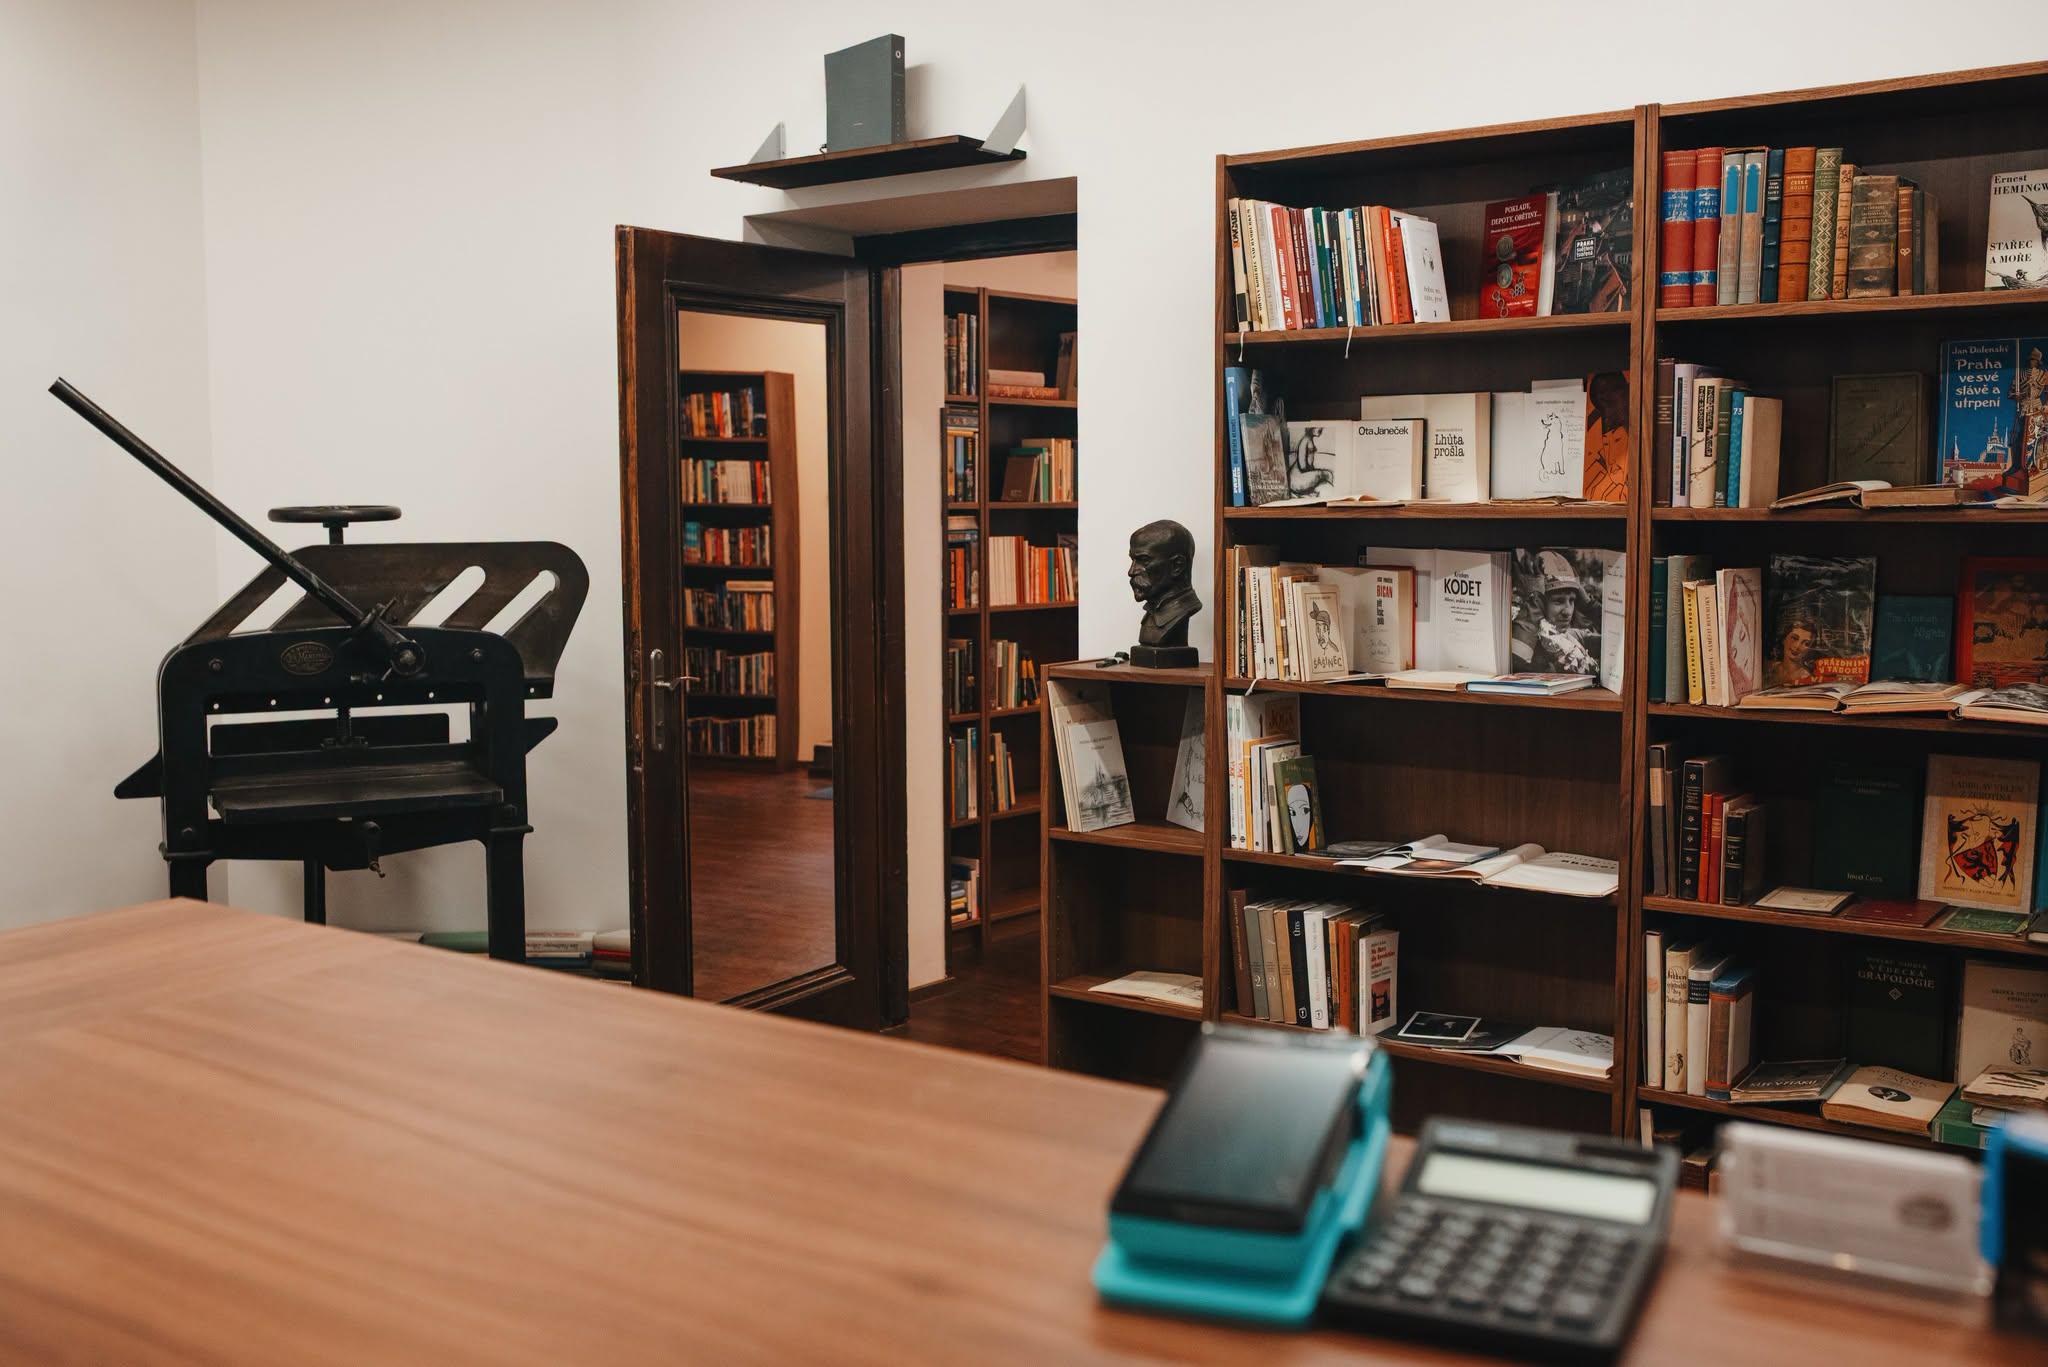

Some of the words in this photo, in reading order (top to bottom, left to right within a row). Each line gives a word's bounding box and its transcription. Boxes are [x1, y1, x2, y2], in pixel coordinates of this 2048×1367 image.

[1994, 174, 2027, 184] Ernest
[1504, 202, 1531, 214] POKLADY,
[1576, 239, 1594, 248] PRAHA
[1989, 239, 2034, 251] STAŘEC
[1990, 256, 1997, 264] A
[1999, 252, 2032, 264] MOŘE
[1955, 358, 2002, 371] Praha
[1959, 374, 1975, 383] ve
[1976, 371, 1999, 382] své
[1955, 384, 1989, 396] slávě
[1954, 396, 2001, 409] utrpení
[1732, 407, 1743, 415] 73
[1358, 426, 1374, 436] Ota
[1375, 425, 1409, 436] Janeček
[1434, 433, 1464, 446] Lhůta
[1434, 446, 1465, 459] prošla
[1376, 584, 1393, 598] BICAN
[1444, 578, 1482, 597] KODET
[1857, 969, 1936, 989] GRAFOLOGIE
